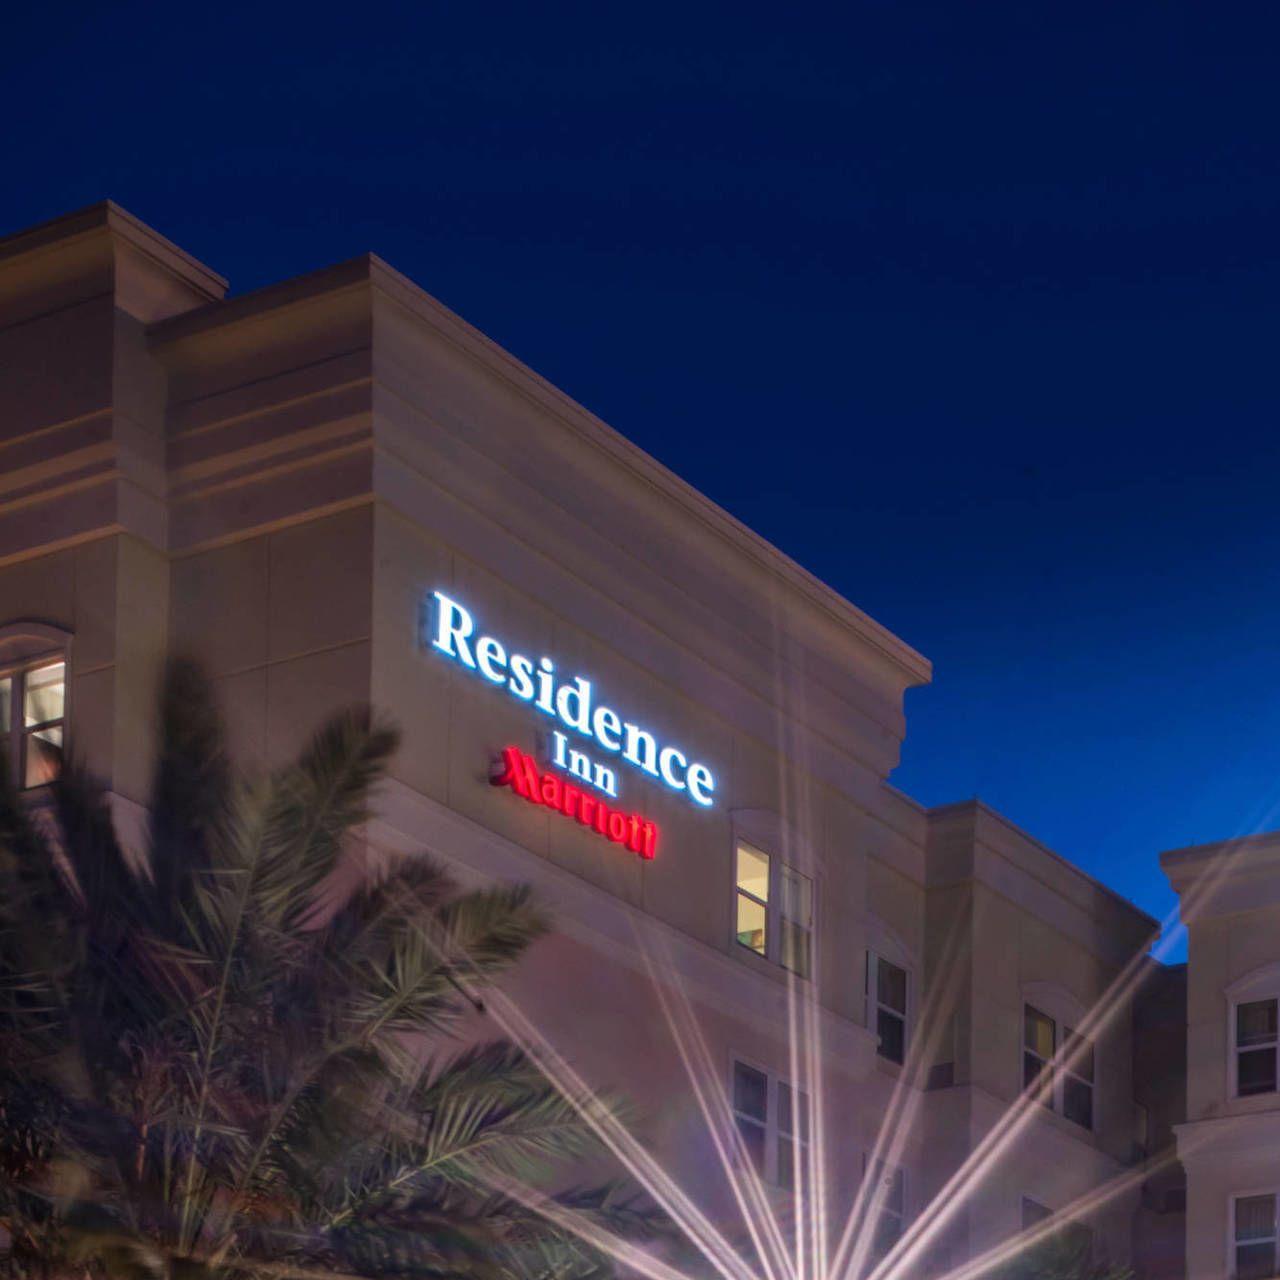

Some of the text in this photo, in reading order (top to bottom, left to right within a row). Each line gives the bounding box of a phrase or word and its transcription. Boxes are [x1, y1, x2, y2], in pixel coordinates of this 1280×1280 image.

[431, 590, 716, 807] Residence
[489, 745, 659, 860] Marriott
[552, 730, 617, 798] Inn
